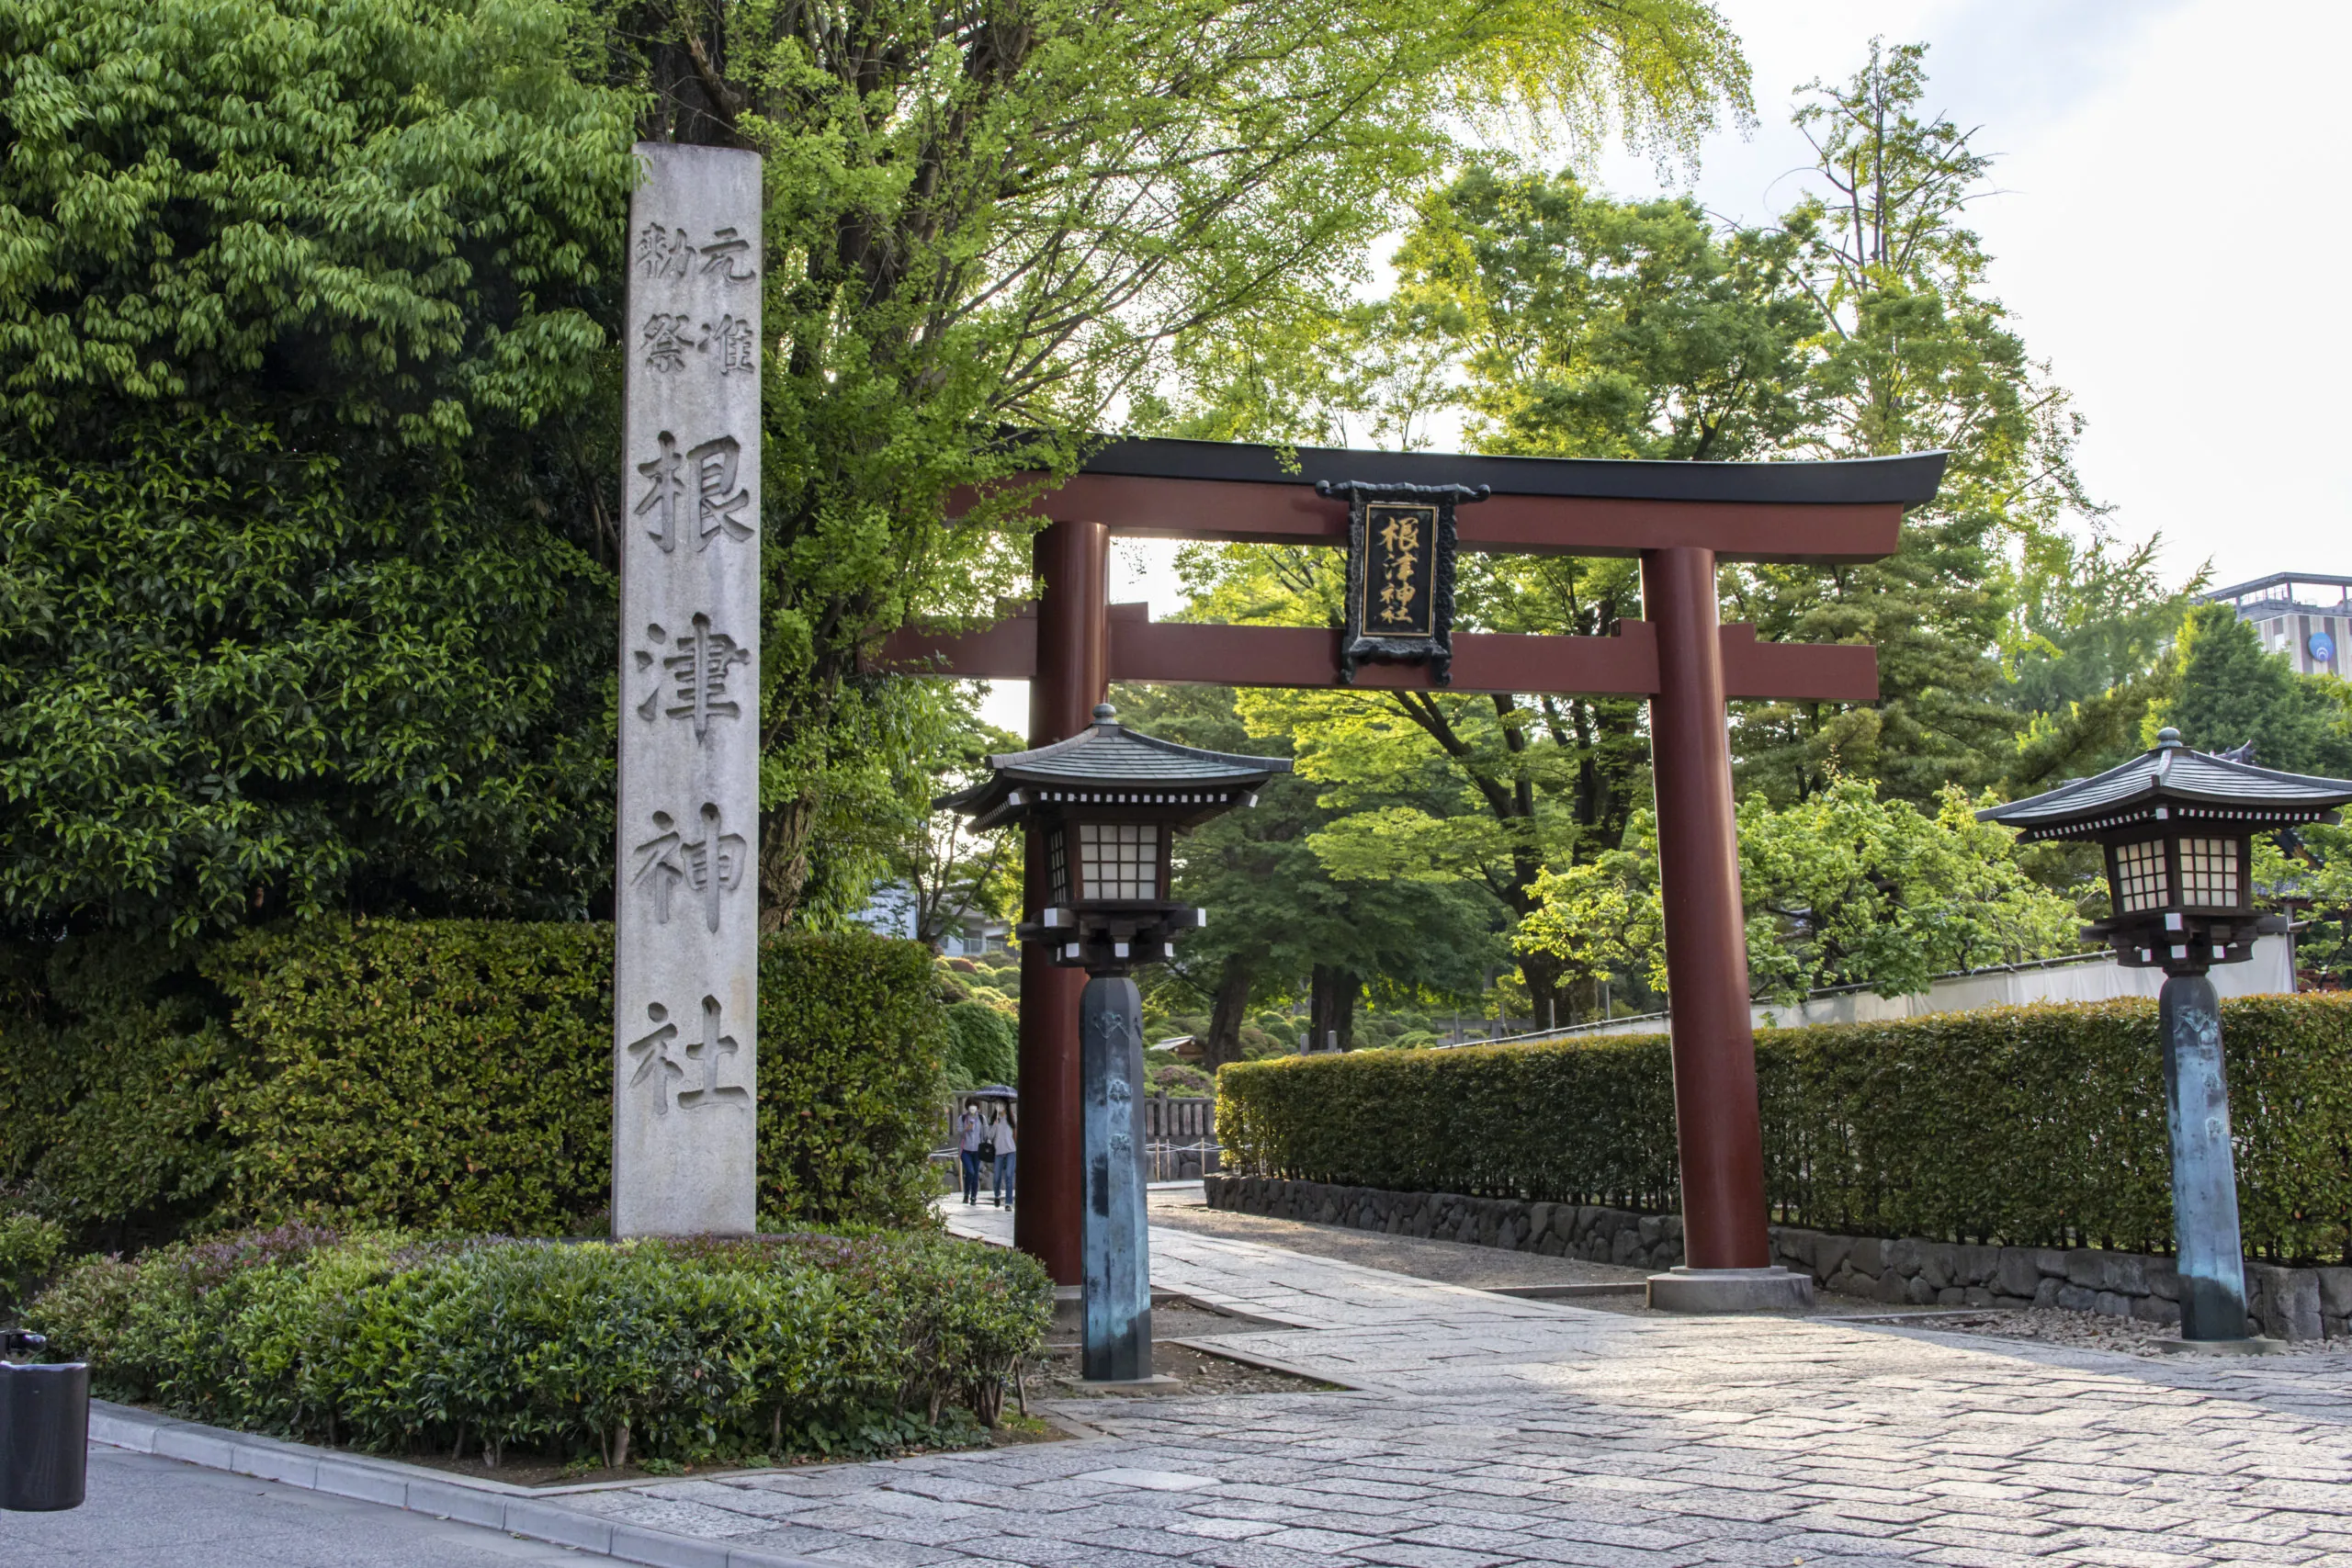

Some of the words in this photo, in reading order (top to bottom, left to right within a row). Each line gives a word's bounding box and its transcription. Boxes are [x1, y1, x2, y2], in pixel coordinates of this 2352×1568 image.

[1378, 516, 1419, 624] 根津神社
[628, 430, 755, 1114] 根津神社
